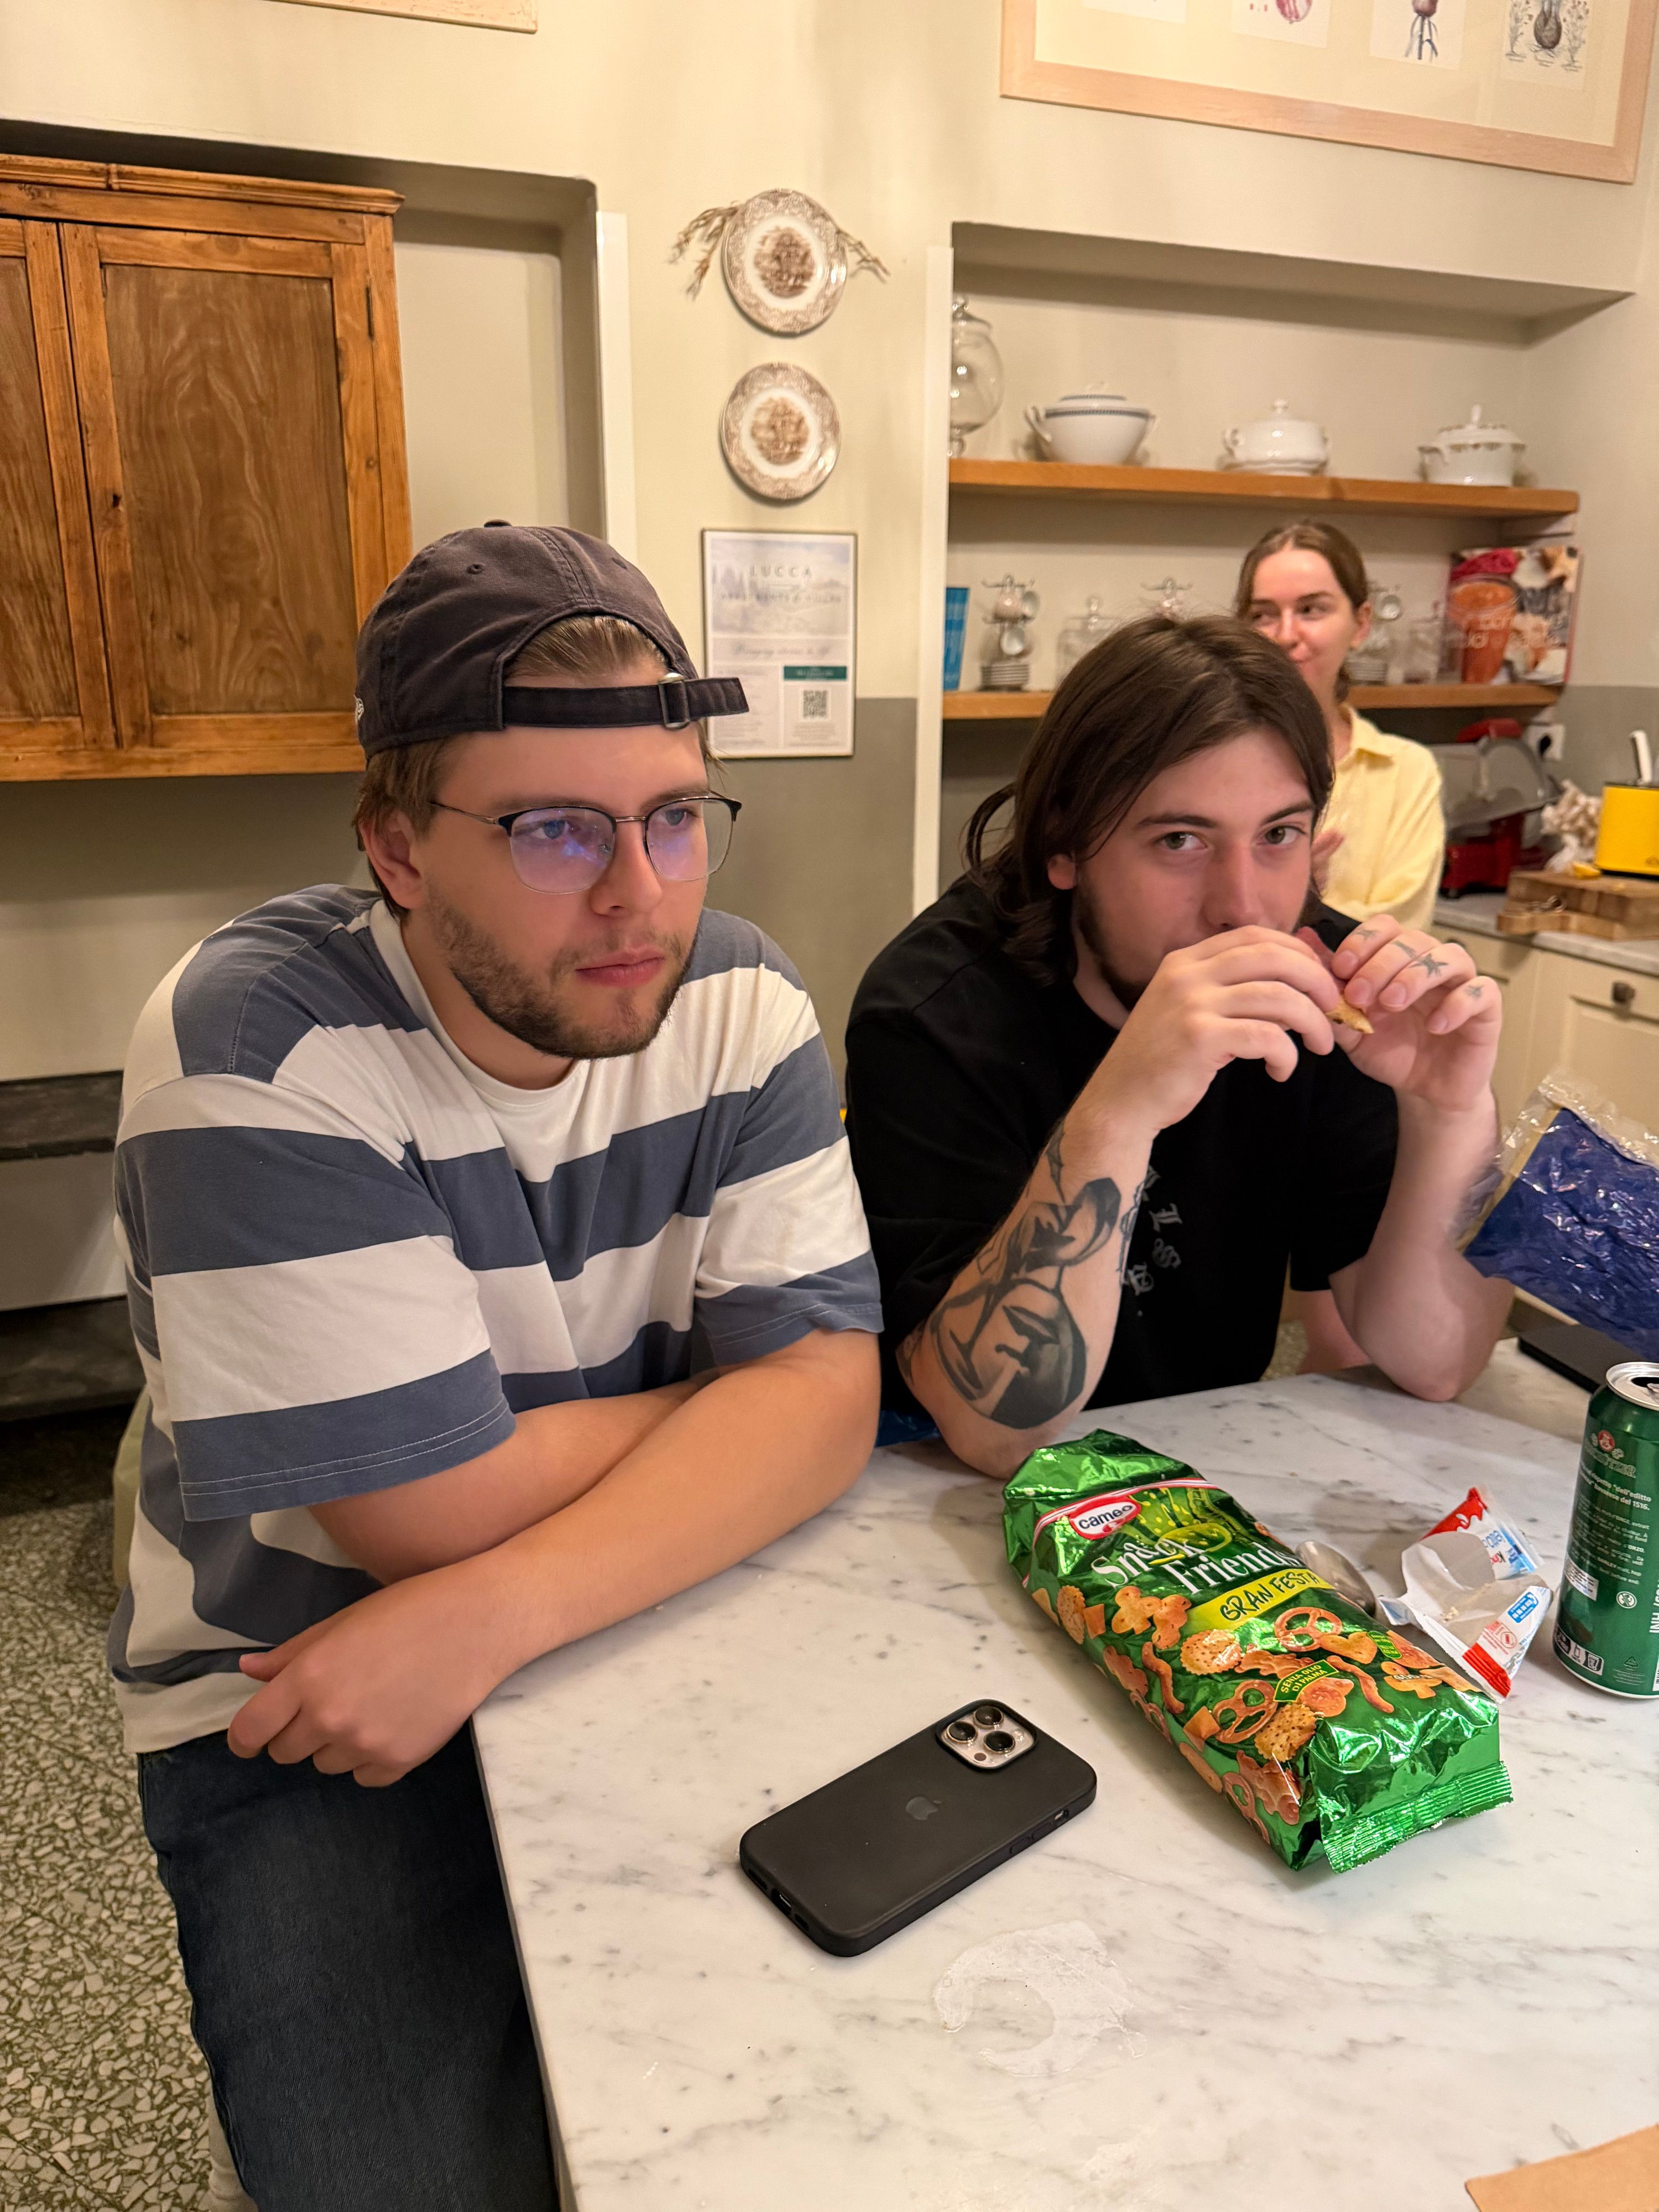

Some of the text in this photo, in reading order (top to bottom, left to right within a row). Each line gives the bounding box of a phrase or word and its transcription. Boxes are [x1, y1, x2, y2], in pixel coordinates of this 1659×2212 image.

[749, 565, 812, 578] LUCCA
[1078, 1505, 1133, 1529] cameo
[1632, 1501, 1650, 1511] 1516.
[1091, 1538, 1209, 1589] Snack
[1160, 1541, 1301, 1594] Friends
[1220, 1572, 1320, 1621] GRAN FESTA
[1280, 1665, 1322, 1693] SENZA OLIO
[1292, 1670, 1328, 1692] DI PALMA
